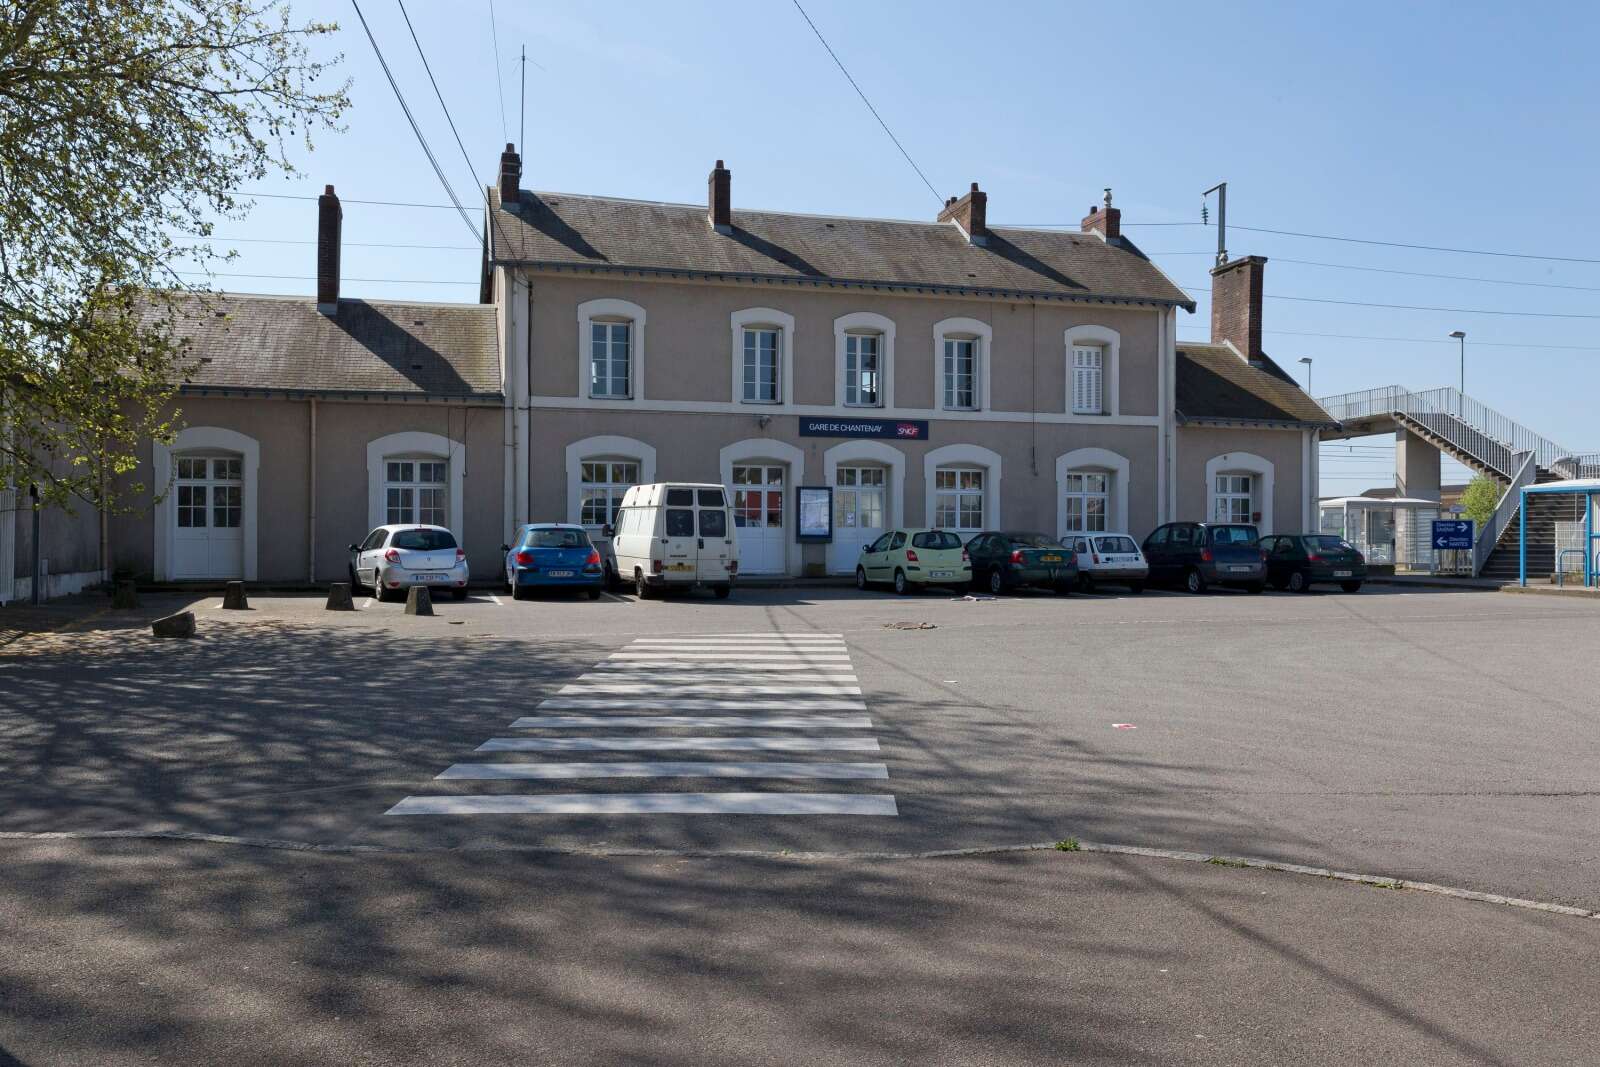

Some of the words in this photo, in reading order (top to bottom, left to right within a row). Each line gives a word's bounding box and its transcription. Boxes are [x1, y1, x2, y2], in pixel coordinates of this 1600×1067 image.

[809, 423, 829, 431] GARE
[830, 423, 840, 432] DE
[840, 424, 882, 433] CHANTENAY
[897, 427, 919, 435] SNCF
